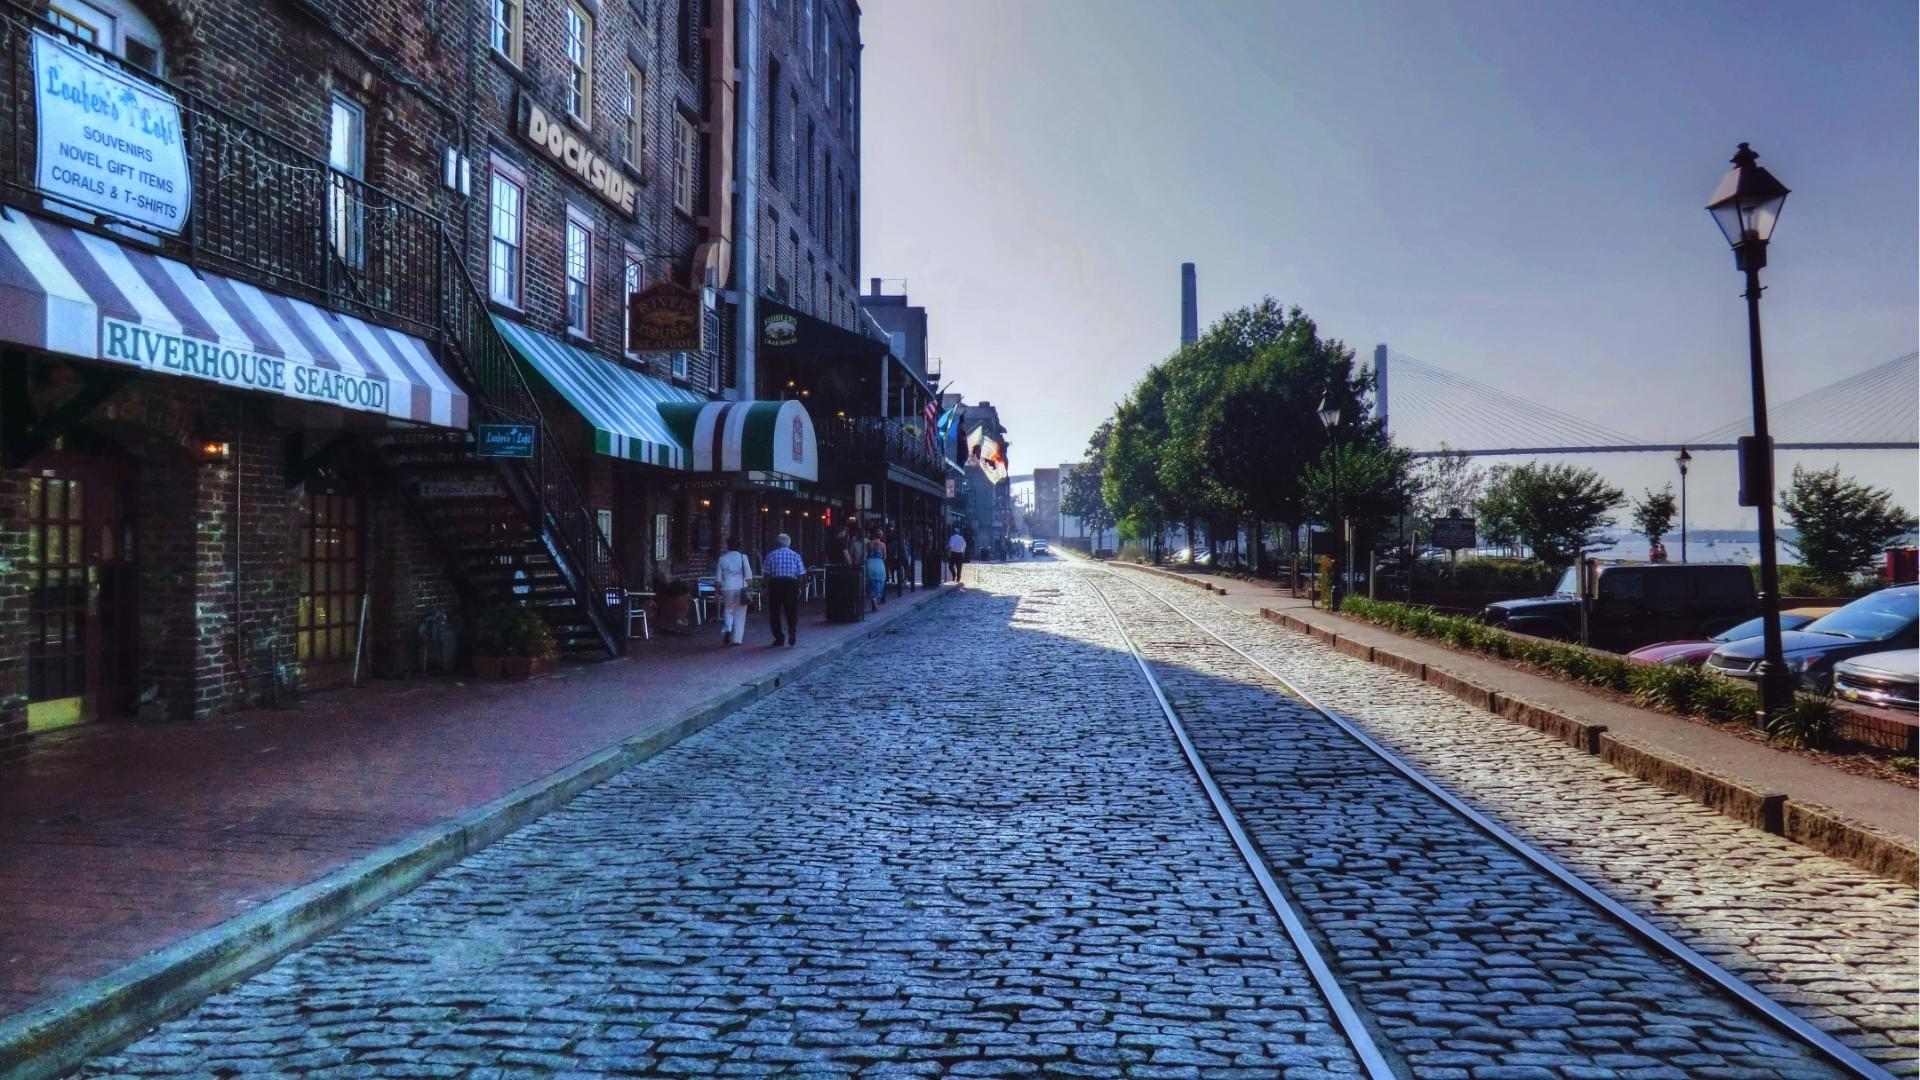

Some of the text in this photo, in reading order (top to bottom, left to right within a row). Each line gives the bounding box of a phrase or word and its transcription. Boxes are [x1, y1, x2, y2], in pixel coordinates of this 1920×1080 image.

[46, 65, 175, 146] Loafer's Loft
[59, 142, 174, 194] NOVEL GIFT ITEMS
[83, 125, 153, 162] SOUVENIRS
[528, 105, 636, 214] DOCKSIDE
[51, 165, 178, 219] CORALS & T-SHIRTS
[107, 321, 384, 408] RIVERHOUSE SEAFOOD
